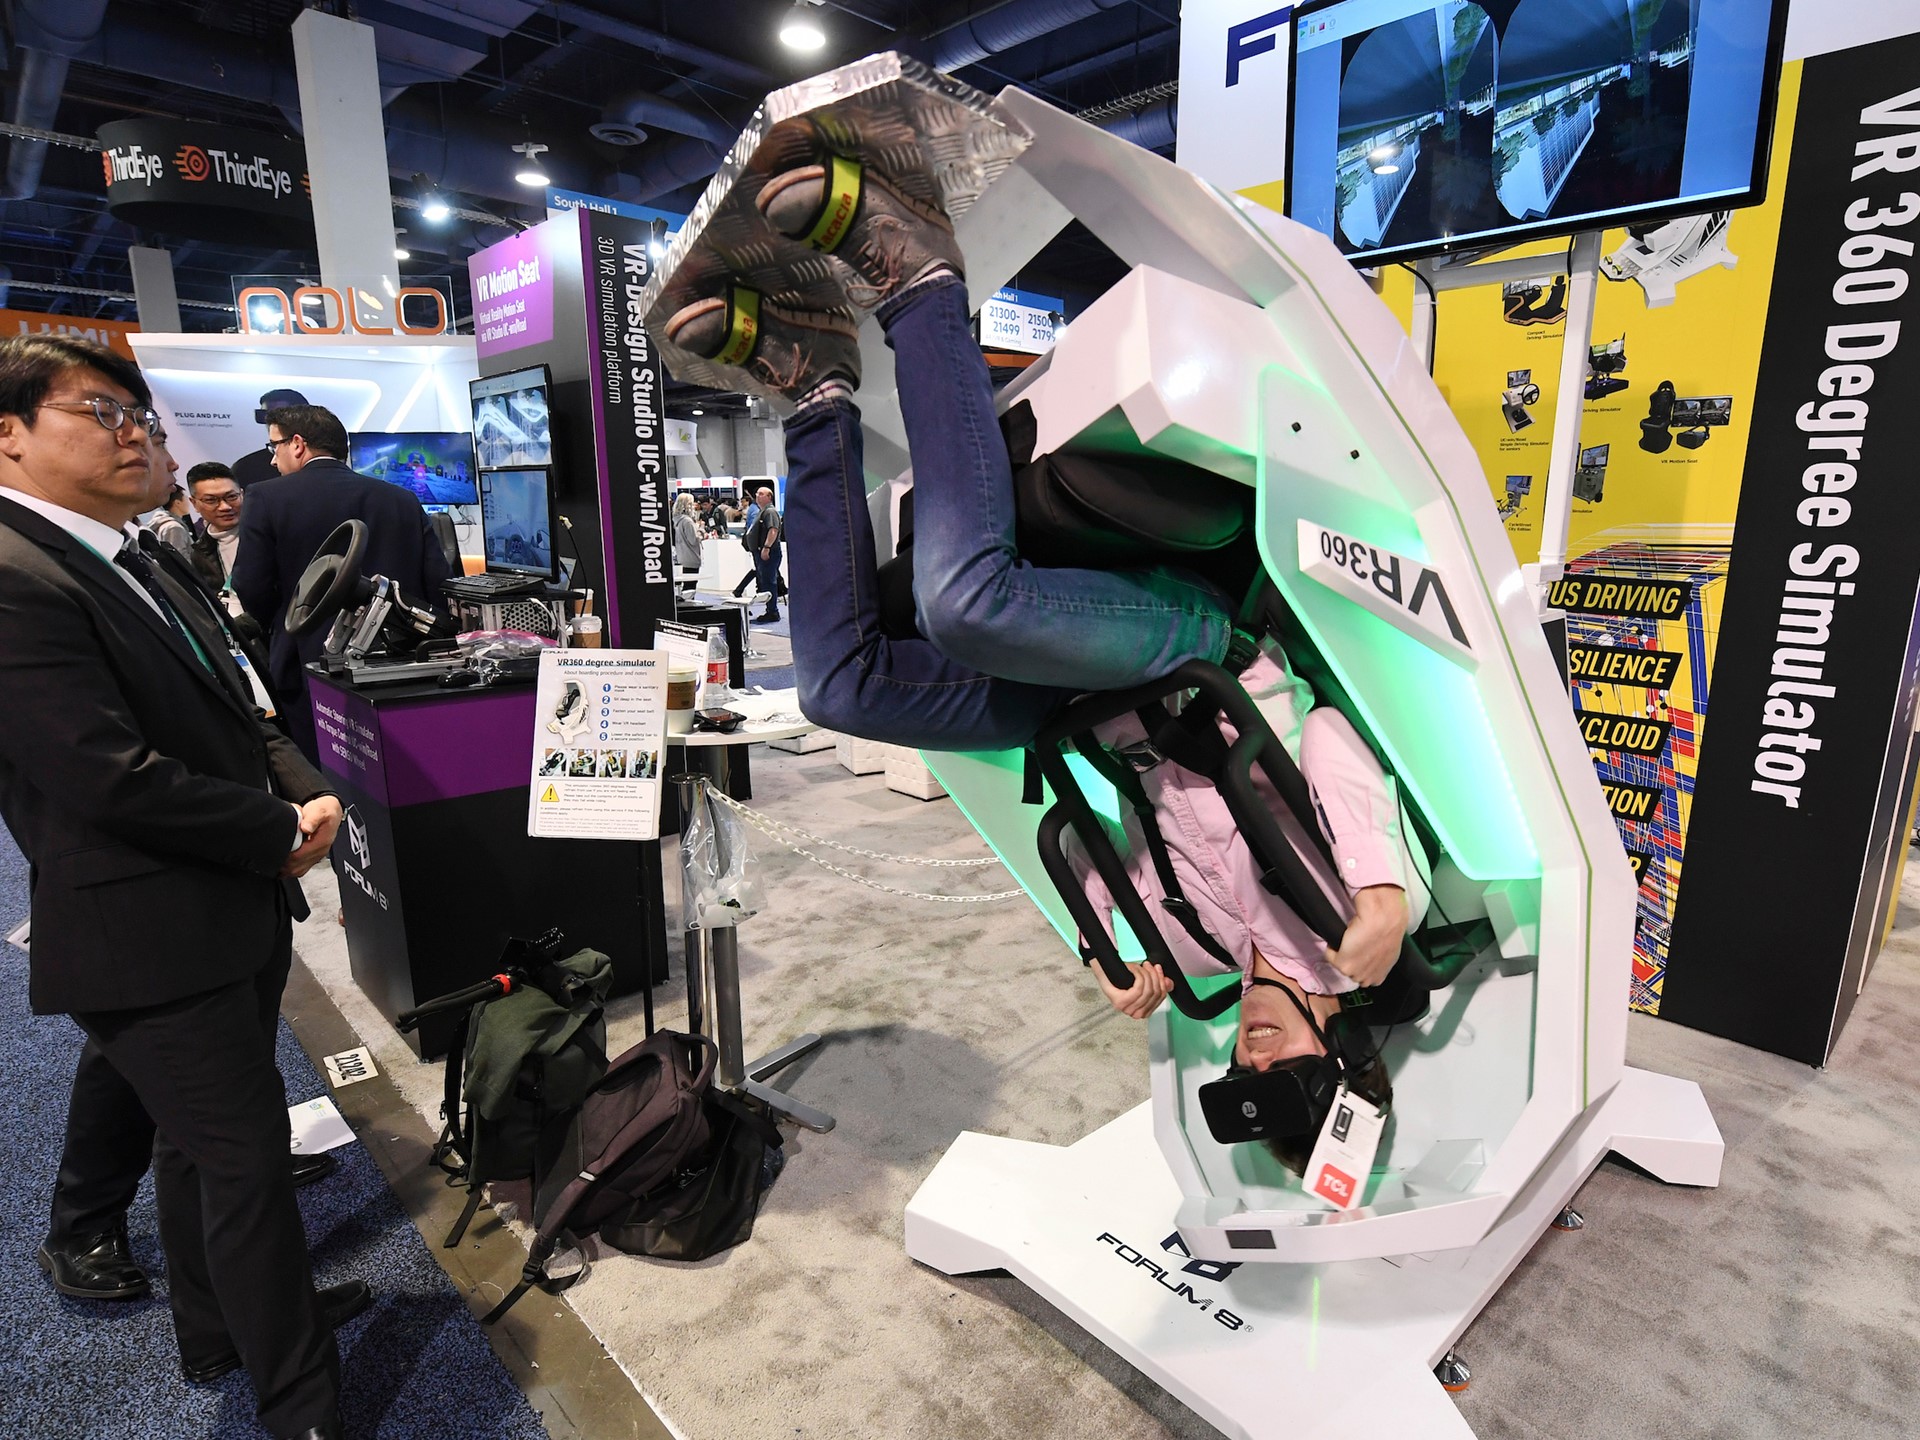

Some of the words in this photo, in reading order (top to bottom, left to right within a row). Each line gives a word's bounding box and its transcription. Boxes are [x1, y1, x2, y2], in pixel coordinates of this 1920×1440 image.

[1851, 86, 1920, 182] VR
[108, 145, 163, 187] ThirdEye
[207, 149, 292, 199] ThirdEye
[554, 195, 587, 209] South
[597, 236, 615, 256] 3D
[599, 257, 617, 275] VR
[1832, 191, 1920, 306] 360
[476, 275, 489, 302] VR
[489, 266, 519, 299] Motion
[518, 255, 540, 287] Seat
[600, 278, 620, 348] simulation
[993, 321, 1020, 336] 21499
[601, 349, 623, 404] platform
[630, 368, 657, 439] Studio
[1795, 320, 1901, 527] Degree
[636, 445, 668, 583] UC-win/Road
[1320, 530, 1472, 650] VR360
[1583, 582, 1681, 614] DRIVING
[557, 658, 583, 667] VR360
[585, 658, 614, 668] degree
[616, 658, 656, 668] simulator
[1569, 648, 1671, 684] SILIENCE
[1750, 542, 1860, 809] Simulator
[1584, 717, 1661, 751] CLOUD
[1323, 1173, 1349, 1198] TCL
[1096, 1231, 1214, 1311] FORUM
